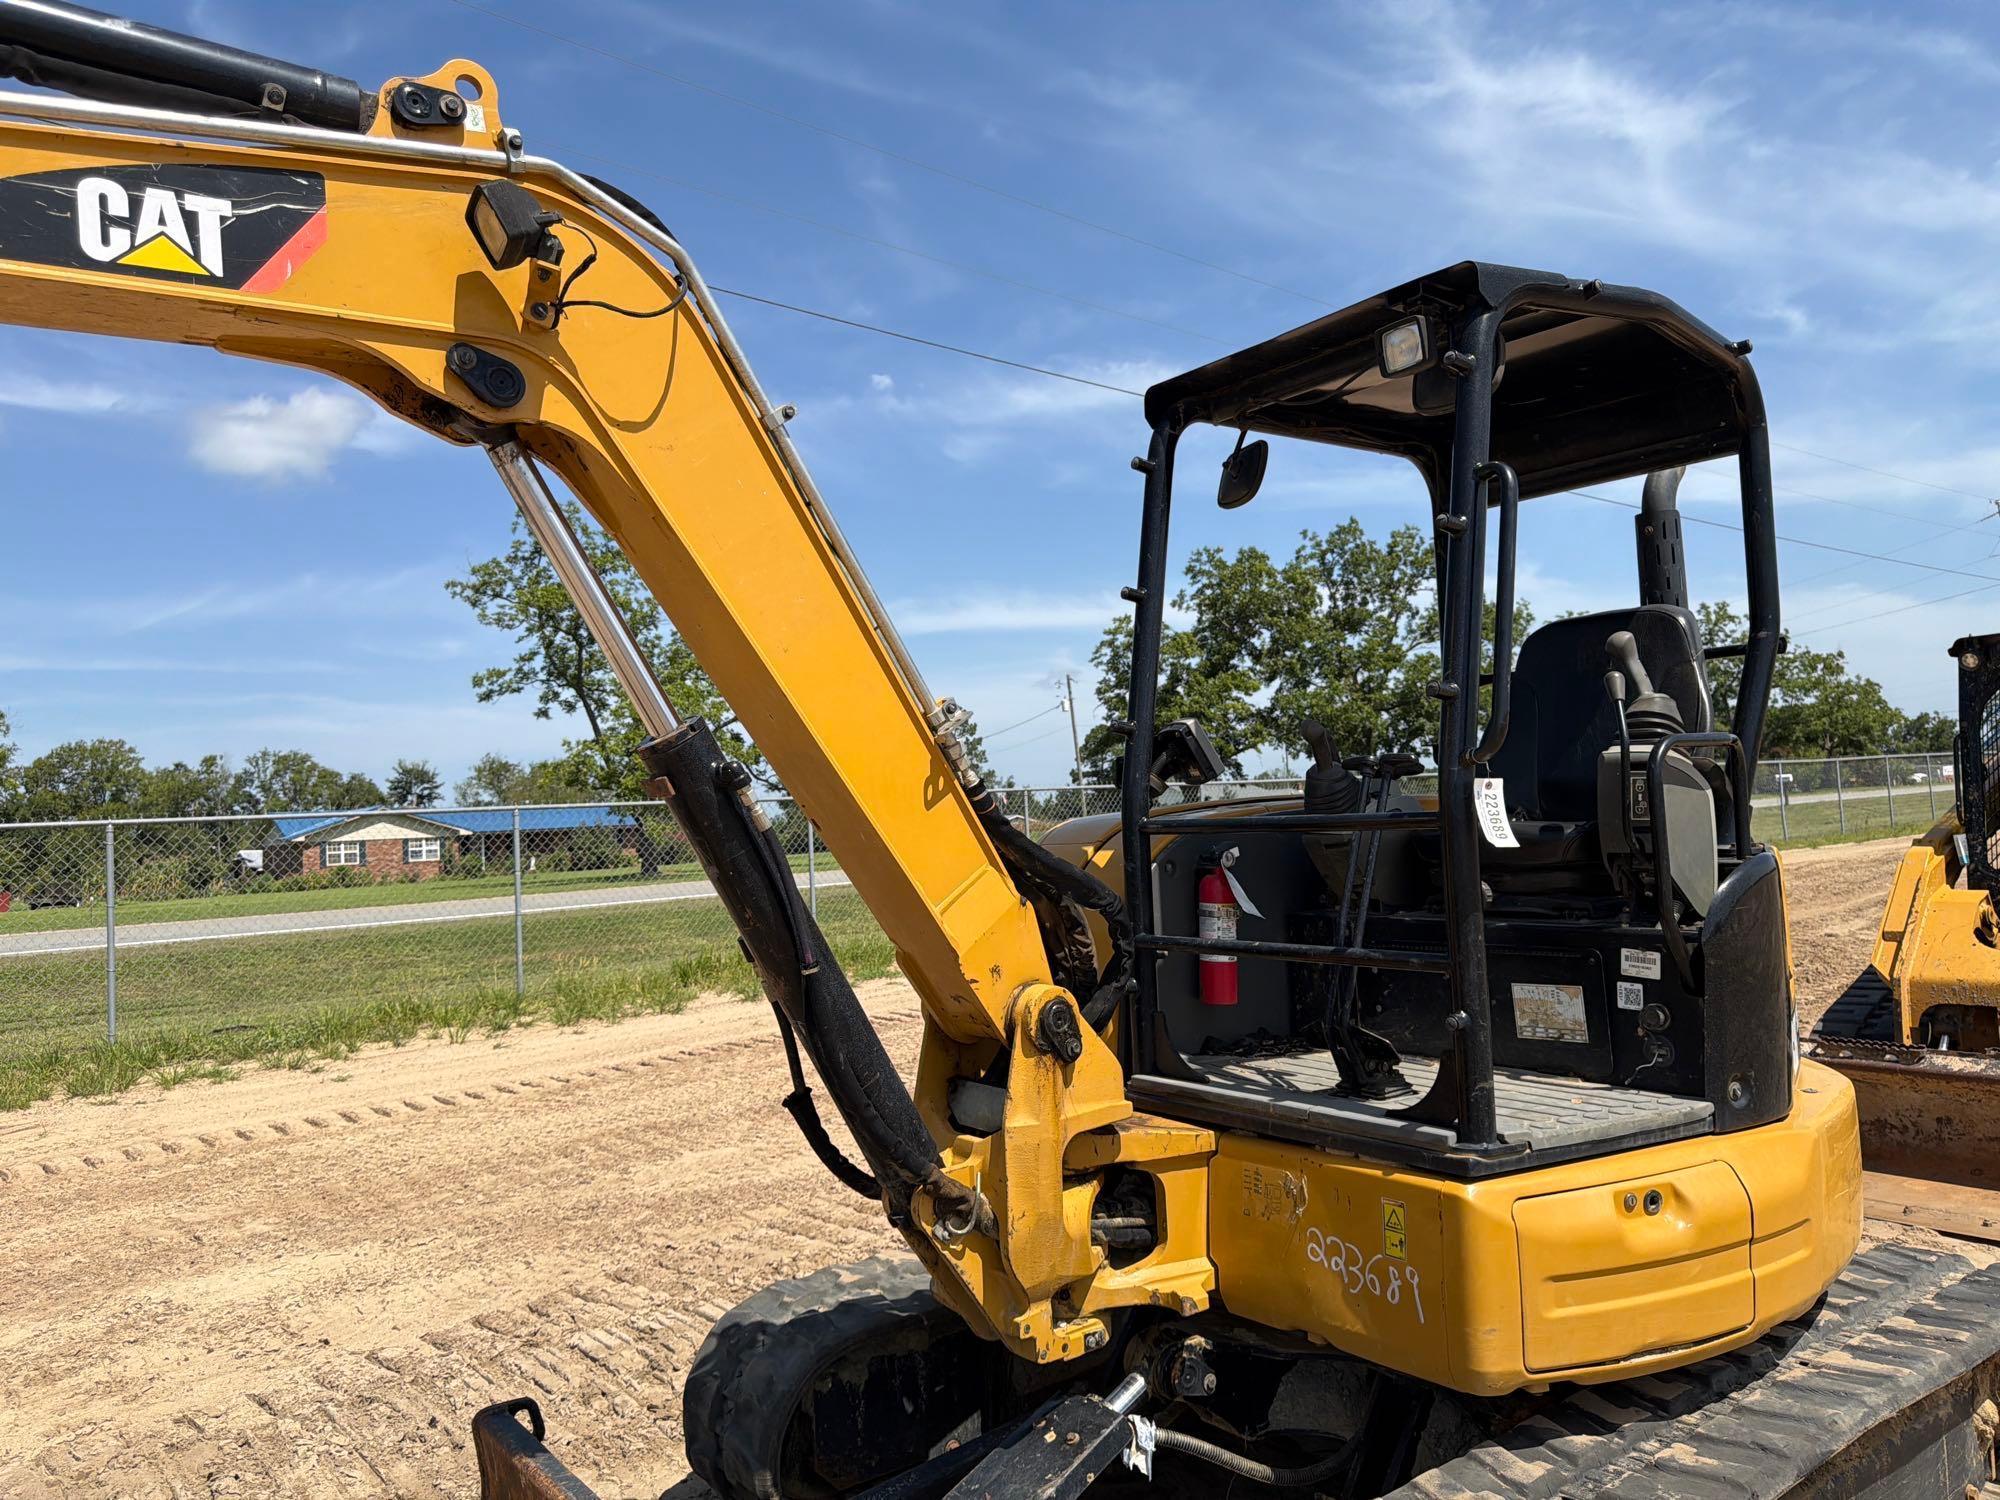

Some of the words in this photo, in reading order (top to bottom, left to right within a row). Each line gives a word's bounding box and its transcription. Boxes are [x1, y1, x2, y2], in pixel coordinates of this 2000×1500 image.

[76, 177, 232, 278] CAT
[1484, 793, 1508, 840] 223689
[1307, 1227, 1424, 1325] 223689
